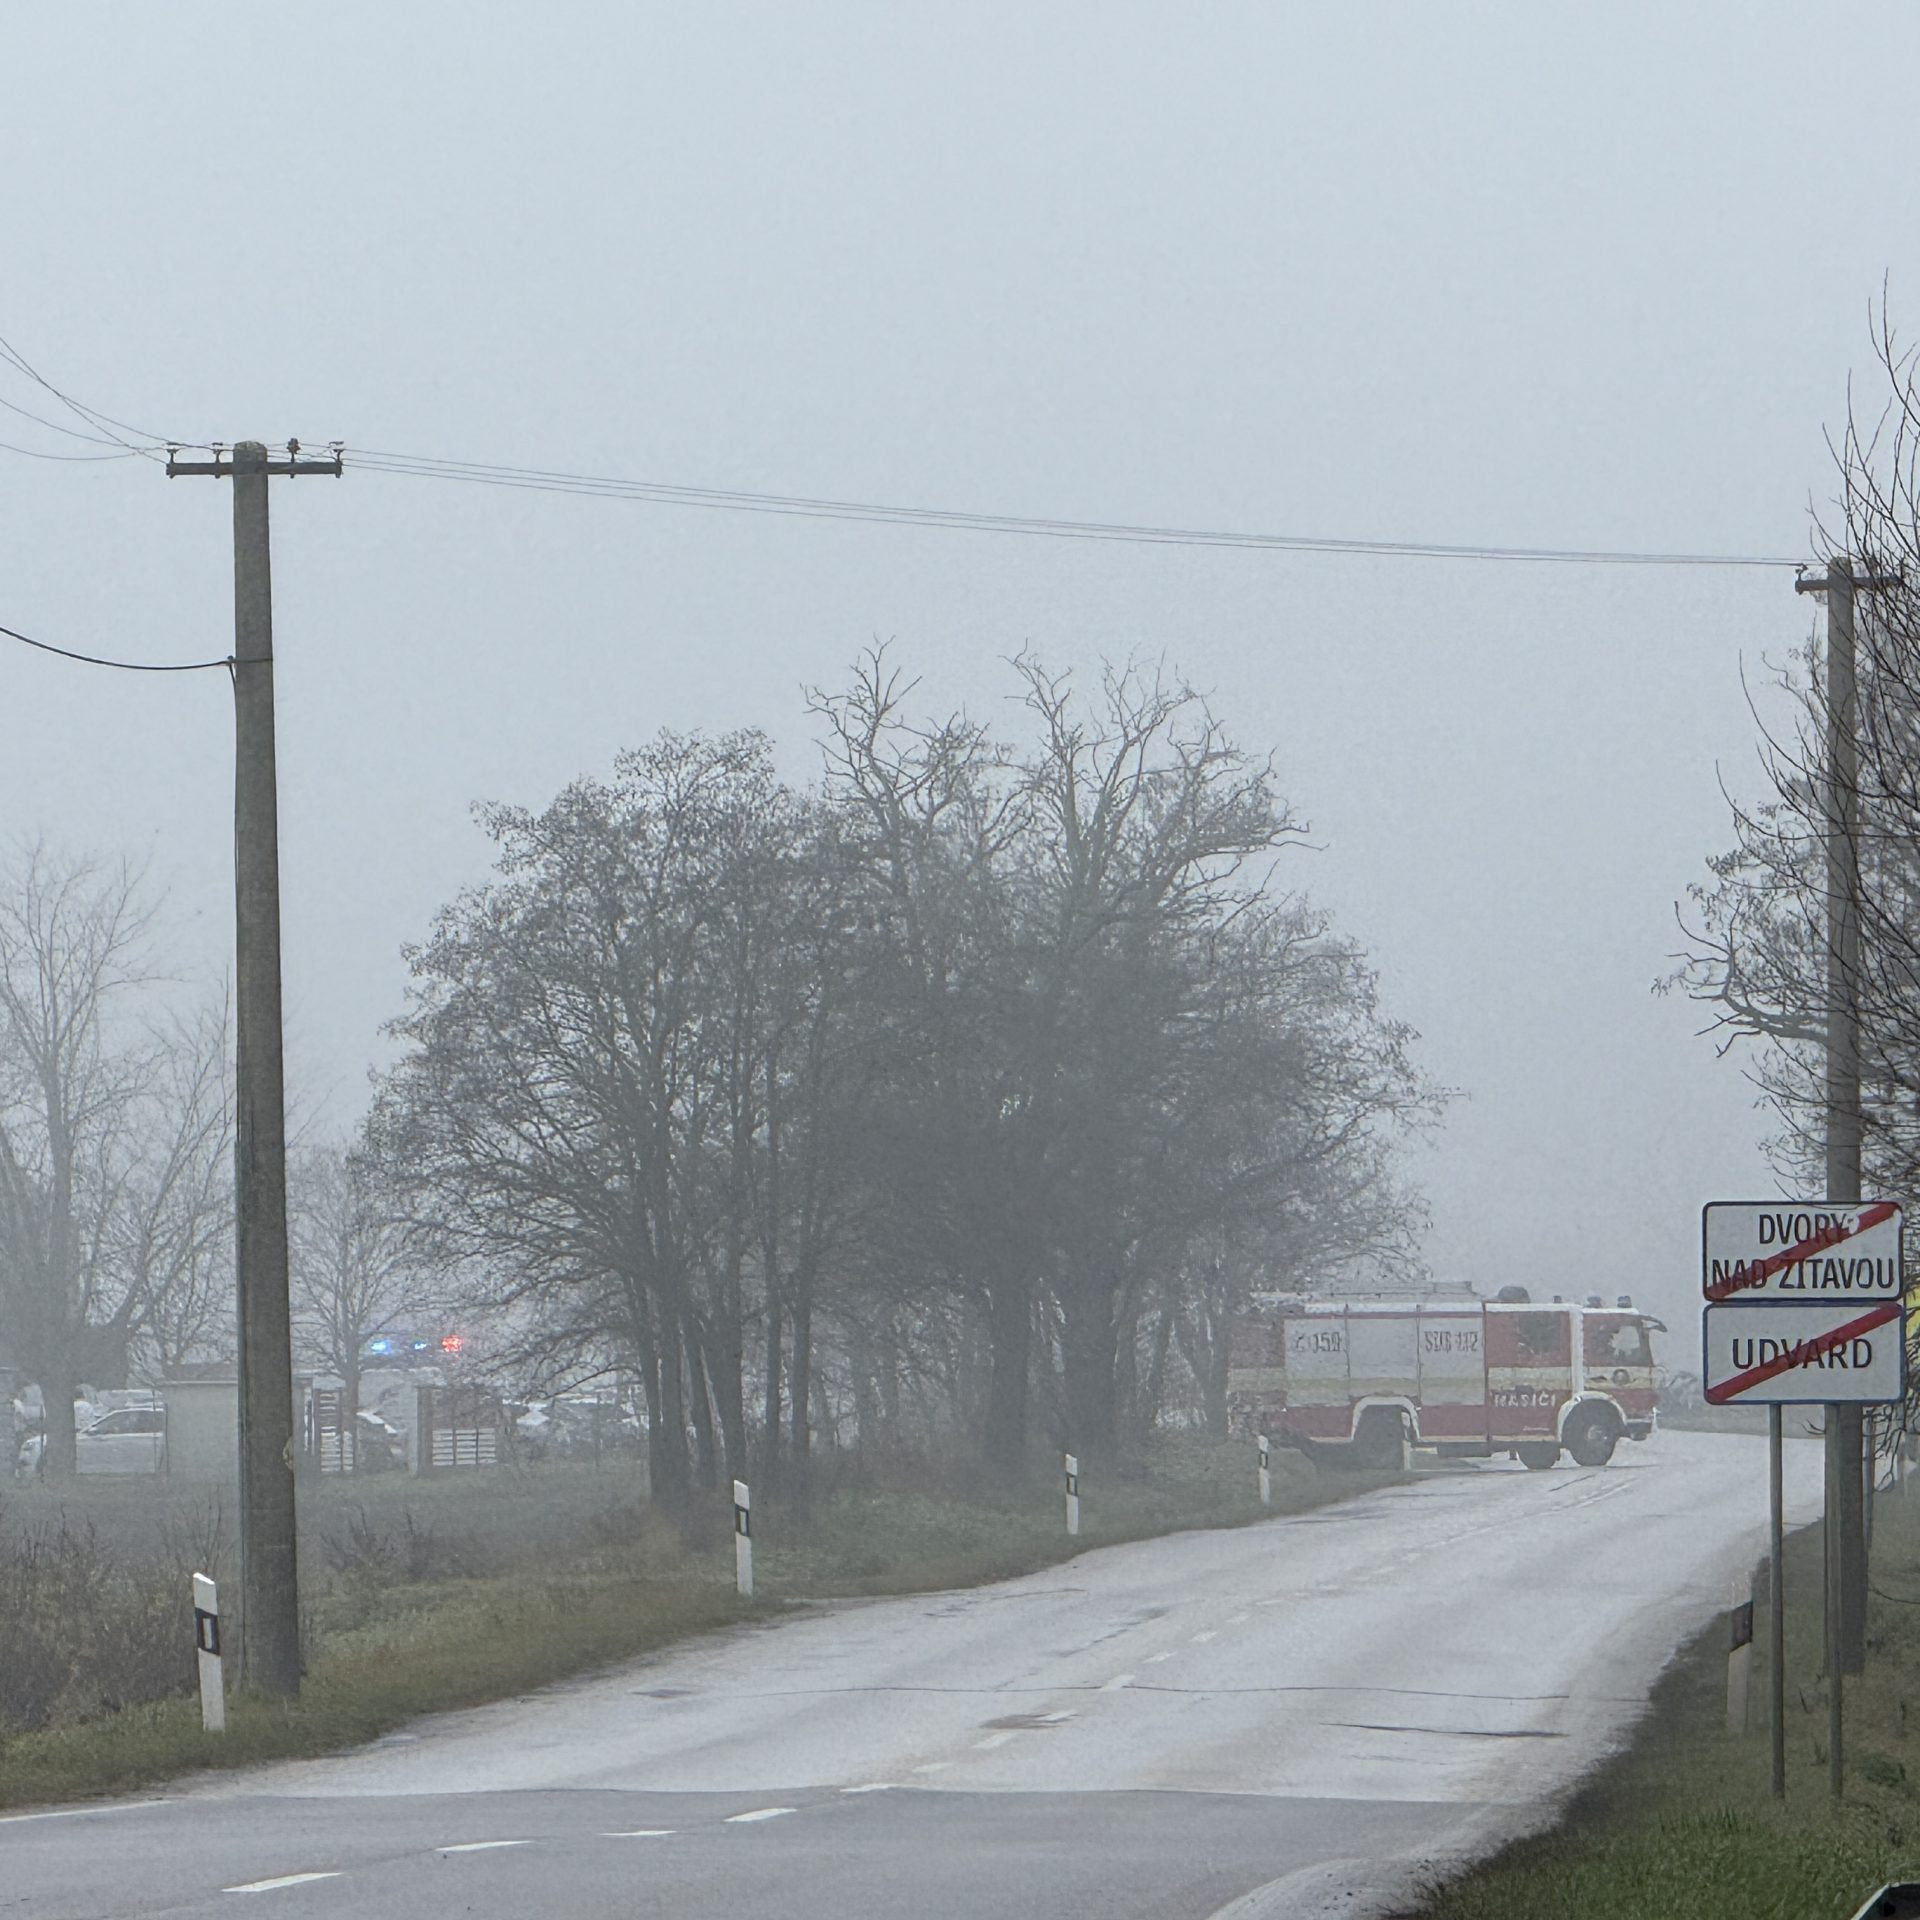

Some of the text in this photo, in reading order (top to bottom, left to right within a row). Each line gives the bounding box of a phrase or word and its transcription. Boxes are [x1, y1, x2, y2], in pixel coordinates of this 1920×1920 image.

[1758, 1212, 1847, 1244] DVORY
[1711, 1258, 1767, 1289] NAD
[1731, 1338, 1873, 1369] UDVARD
